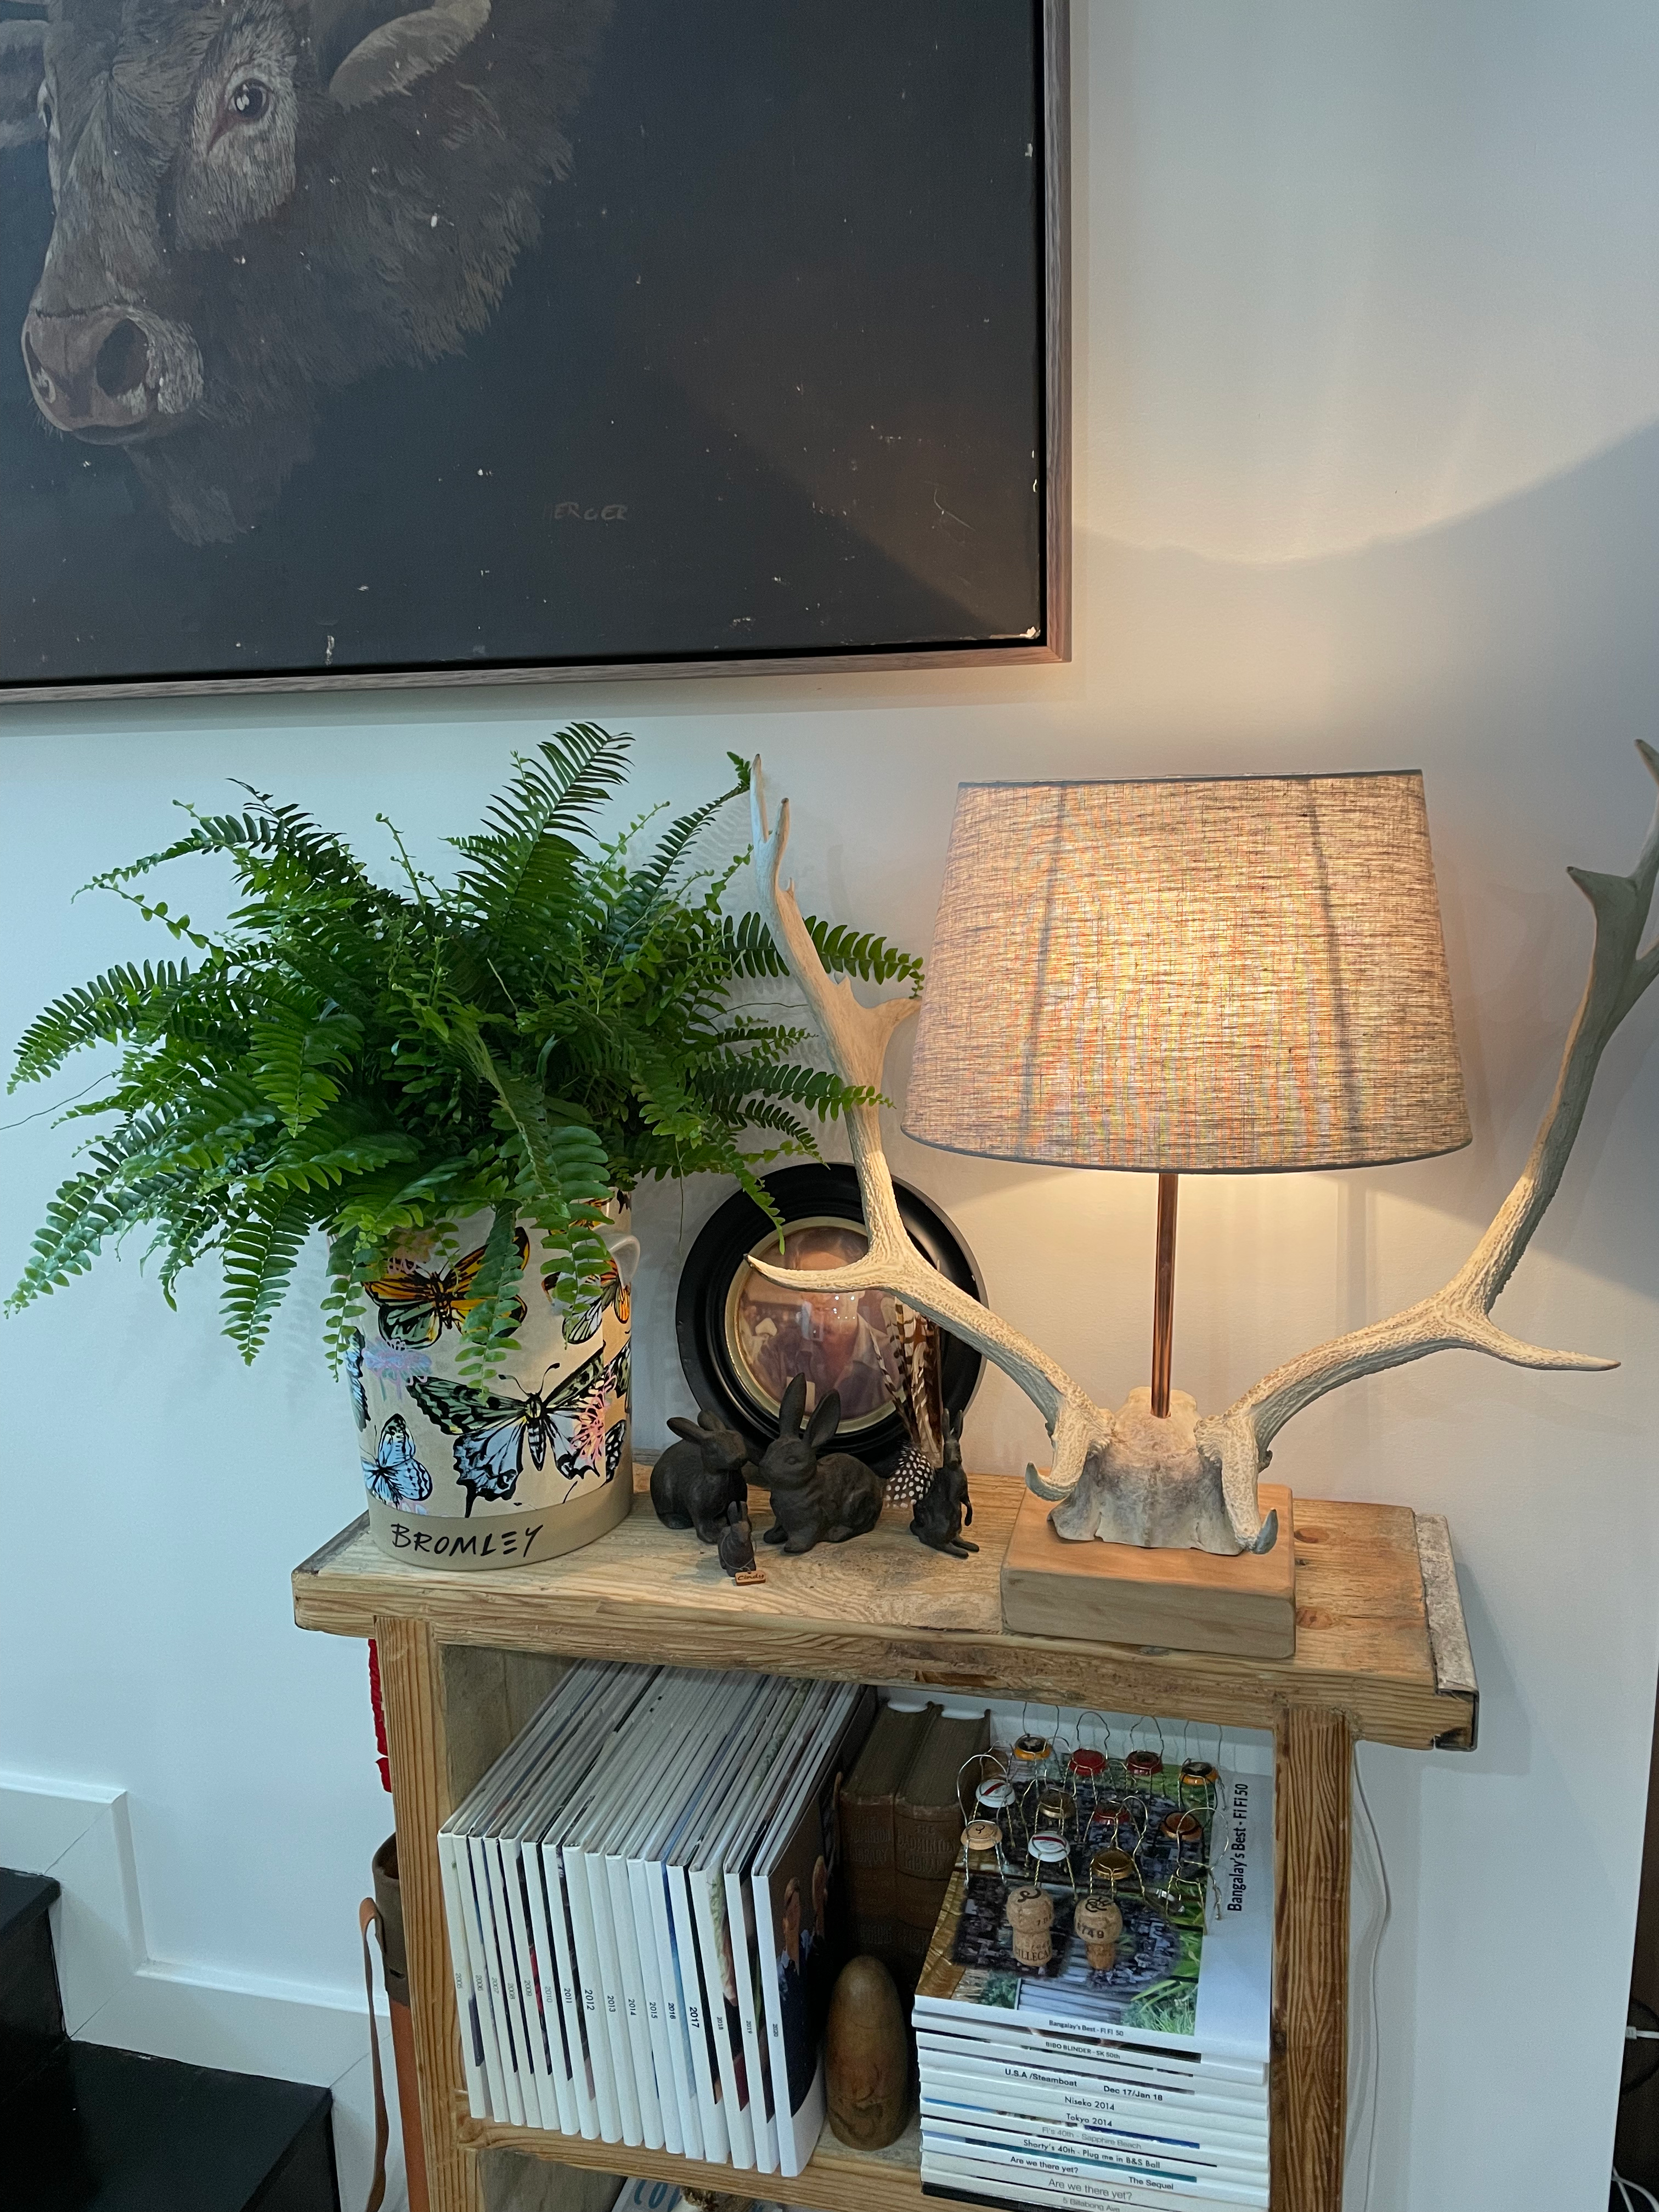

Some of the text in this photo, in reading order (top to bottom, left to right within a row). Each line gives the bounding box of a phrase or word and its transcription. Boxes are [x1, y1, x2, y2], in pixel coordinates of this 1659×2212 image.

[391, 1523, 543, 1558] BROMLEY
[1234, 1784, 1248, 1796] 50
[1234, 1798, 1248, 1807] Fi
[1233, 1809, 1247, 1819] Fi
[1231, 1827, 1246, 1850] Best
[1227, 1853, 1247, 1911] Bangalay's
[564, 1988, 572, 2003] 2011
[585, 1989, 595, 2011] 2012
[607, 1995, 616, 2012] 2013
[628, 1999, 636, 2016] 2014
[650, 2002, 658, 2019] 2015
[668, 2002, 676, 2019] 2016
[690, 2007, 699, 2028] 2017
[1049, 2019, 1081, 2030] Bangalay's
[1063, 2045, 1091, 2055] BLINDER
[1005, 2068, 1027, 2079] U.S.A
[1029, 2073, 1077, 2086] /Steamboat
[1104, 2086, 1120, 2094] Dec
[1122, 2089, 1150, 2099] 17/Jan
[1064, 2096, 1114, 2111] Niseko 2014
[1066, 2113, 1112, 2126] Tokyo 2014
[1057, 2130, 1074, 2138] 40th
[1081, 2134, 1115, 2146] Sapphire
[1117, 2140, 1141, 2149] Beach
[1024, 2140, 1054, 2151] Shorty's
[1057, 2146, 1075, 2154] 40th
[1082, 2149, 1099, 2160] Plug
[1126, 2157, 1143, 2166] B&S
[1145, 2160, 1160, 2169] Ball
[1011, 2156, 1024, 2164] Are
[1040, 2162, 1059, 2170] there
[1128, 2176, 1143, 2185] The
[1146, 2180, 1173, 2191] Sequel
[1048, 2179, 1065, 2189] Are
[1085, 2185, 1109, 2196] there
[1111, 2191, 1132, 2200] yet?
[1070, 2199, 1104, 2211] Billabong
